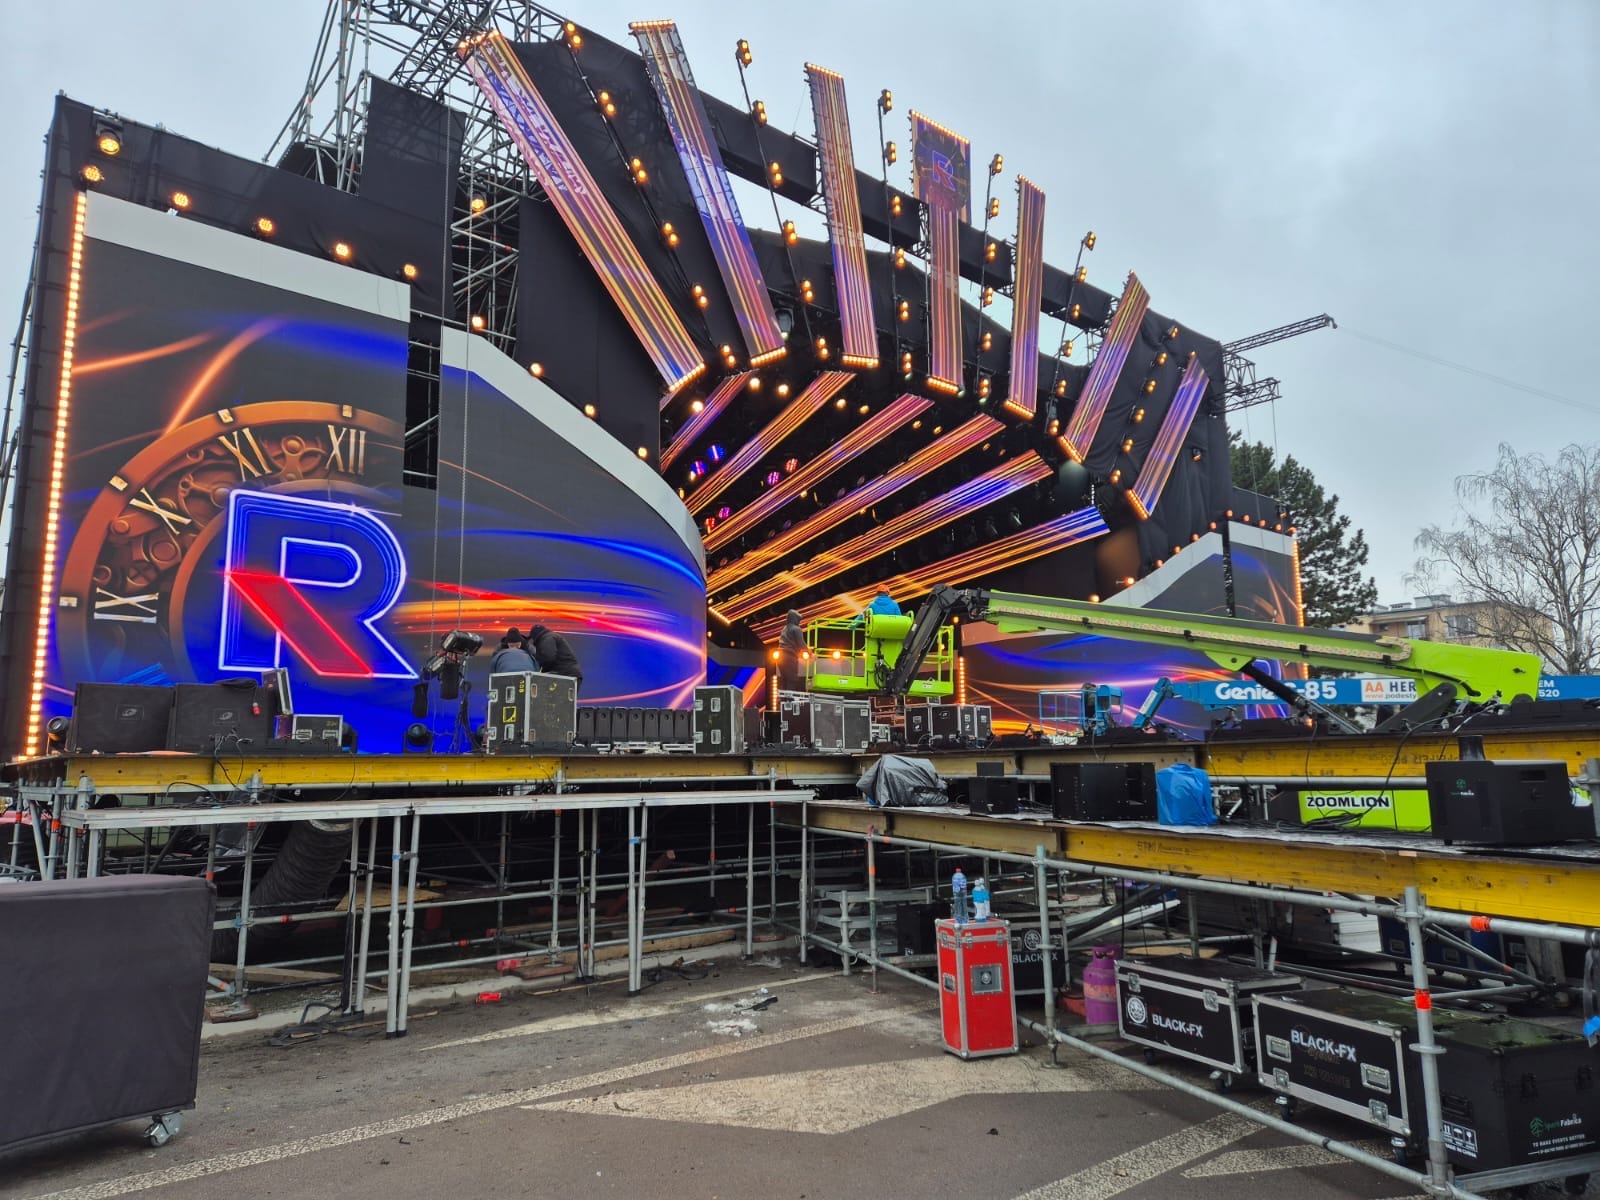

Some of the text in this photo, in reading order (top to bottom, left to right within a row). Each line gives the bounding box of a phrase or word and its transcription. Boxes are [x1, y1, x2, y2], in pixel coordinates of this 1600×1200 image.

[218, 427, 272, 482] XI
[325, 425, 366, 475] XII
[129, 487, 192, 535] X
[218, 487, 419, 680] R
[1215, 682, 1278, 700] Genie
[1365, 681, 1416, 692] AA HER
[1538, 689, 1560, 697] 520
[1307, 796, 1389, 807] ZOOMLION
[1012, 952, 1058, 964] BLACKX
[1152, 1013, 1204, 1038] BLACK-FX
[1290, 1029, 1357, 1063] BLACK-FX
